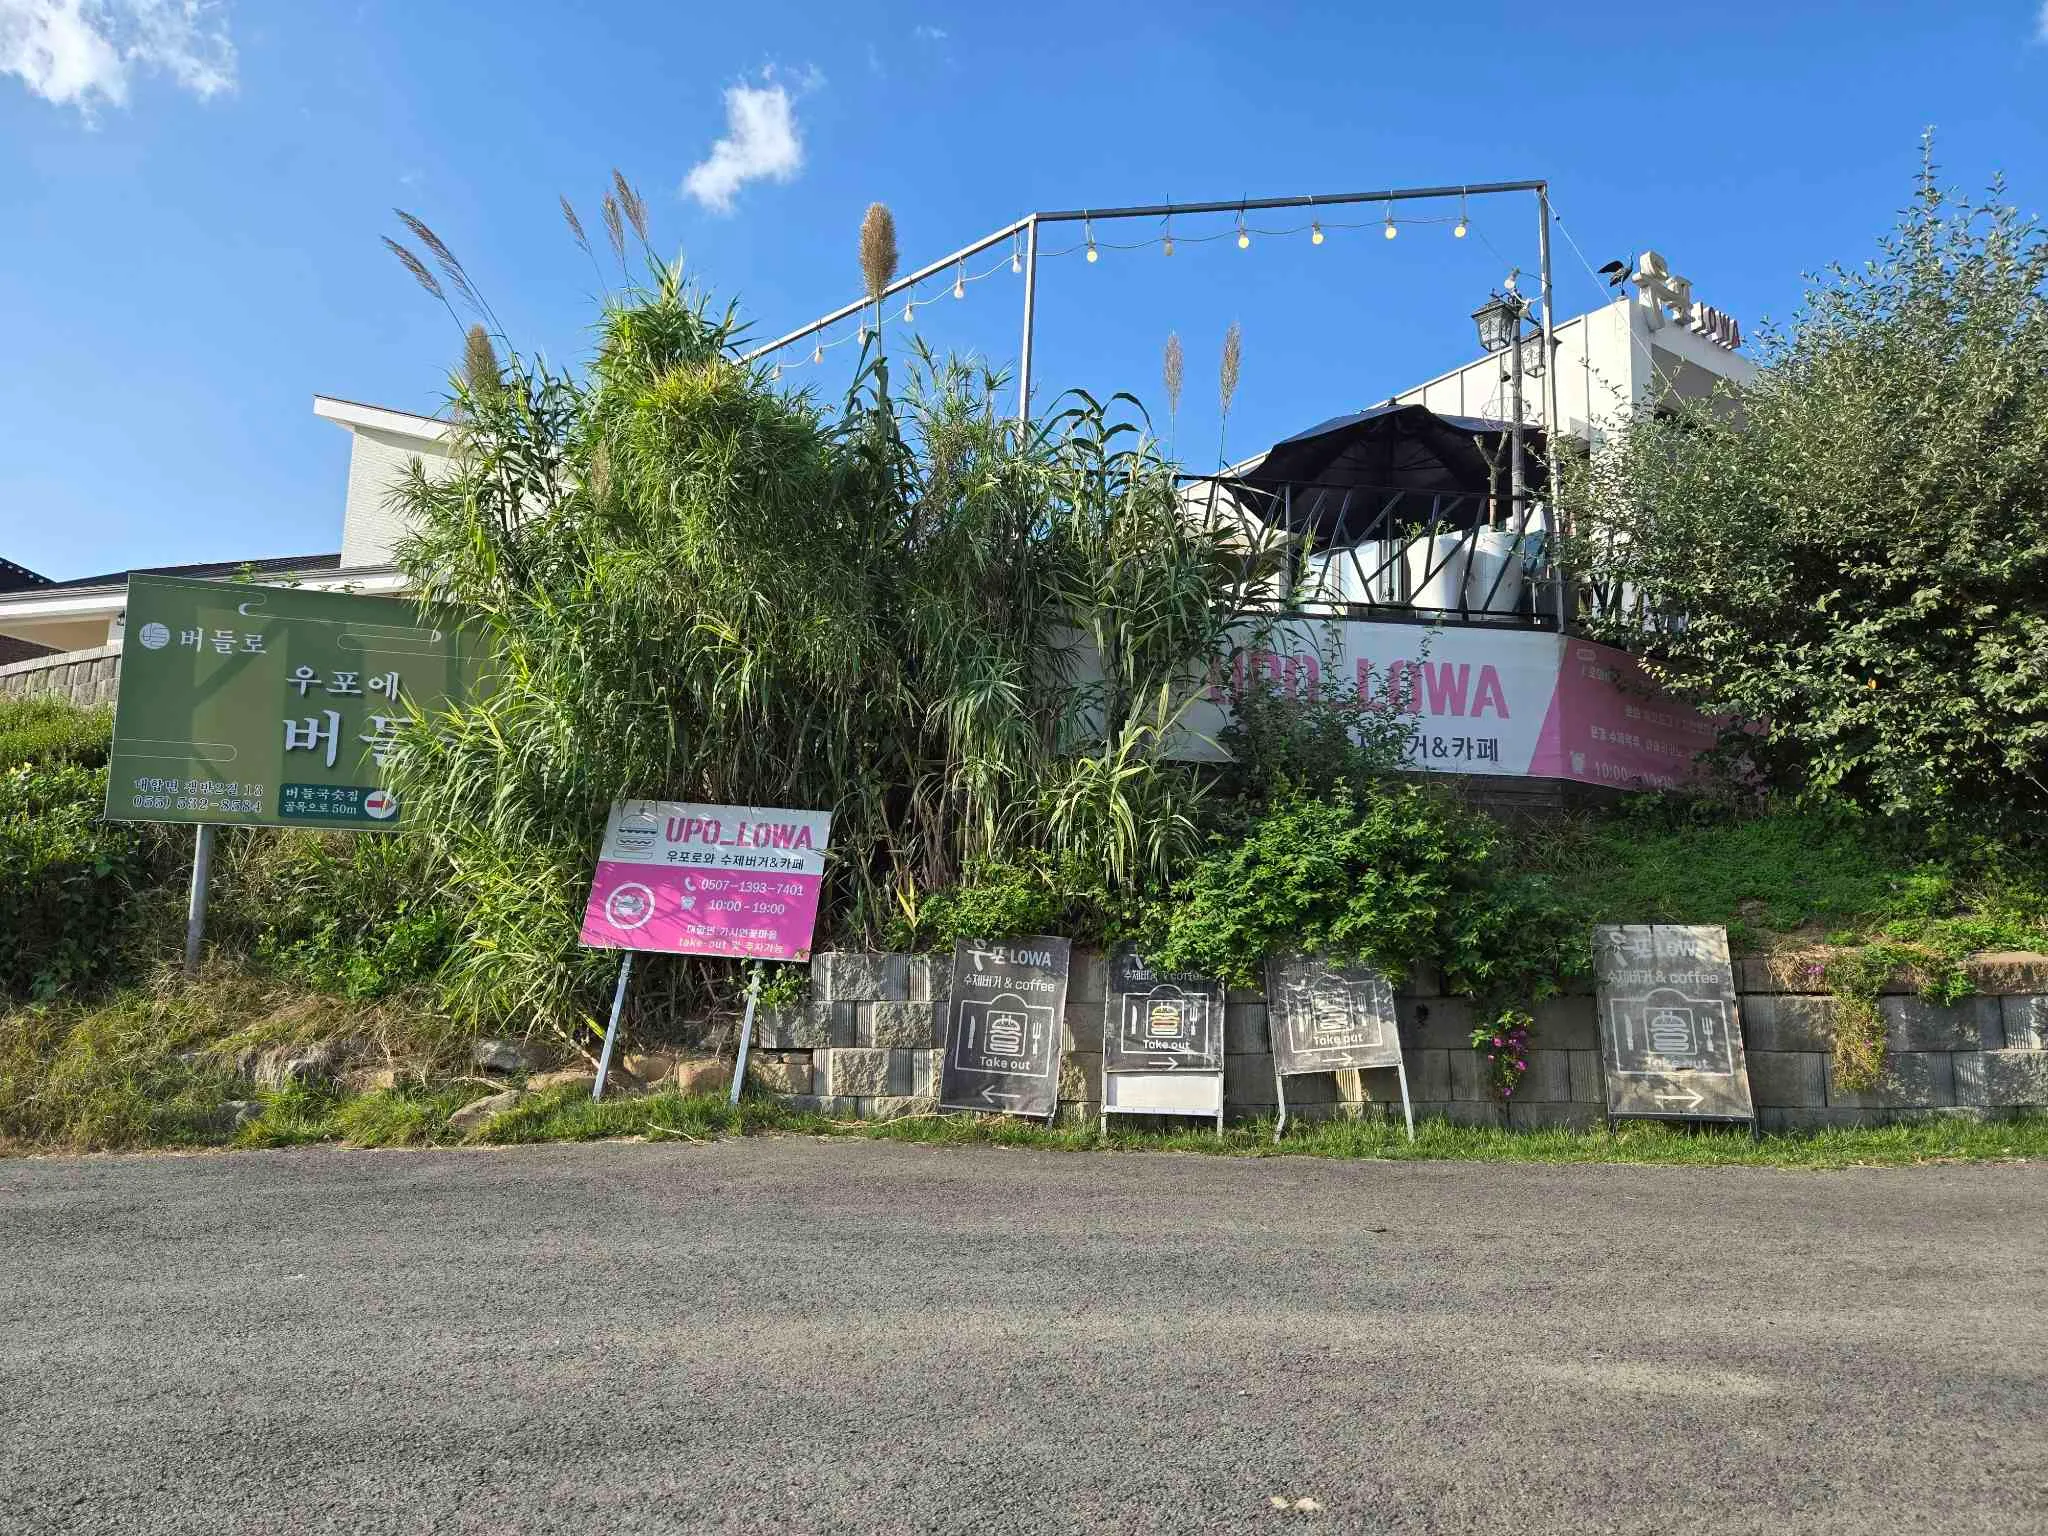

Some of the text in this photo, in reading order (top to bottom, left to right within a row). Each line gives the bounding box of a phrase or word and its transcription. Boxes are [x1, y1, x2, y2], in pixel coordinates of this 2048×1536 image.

[180, 627, 267, 655] 버들로
[286, 665, 400, 701] 우포에
[331, 803, 358, 815] 50m
[665, 817, 813, 850] UPO_LOWA
[666, 850, 805, 870] 우포로와 수제버거&카페
[709, 899, 742, 912] 10:00
[752, 902, 785, 914] 19:00
[1009, 947, 1052, 967] LOWA
[1004, 976, 1013, 989] &
[1015, 978, 1056, 993] coffee
[1655, 970, 1666, 984] &
[1669, 970, 1719, 985] coffee
[1143, 1038, 1191, 1050] Take out
[1313, 1034, 1341, 1046] Take
[980, 1055, 1031, 1071] Take out
